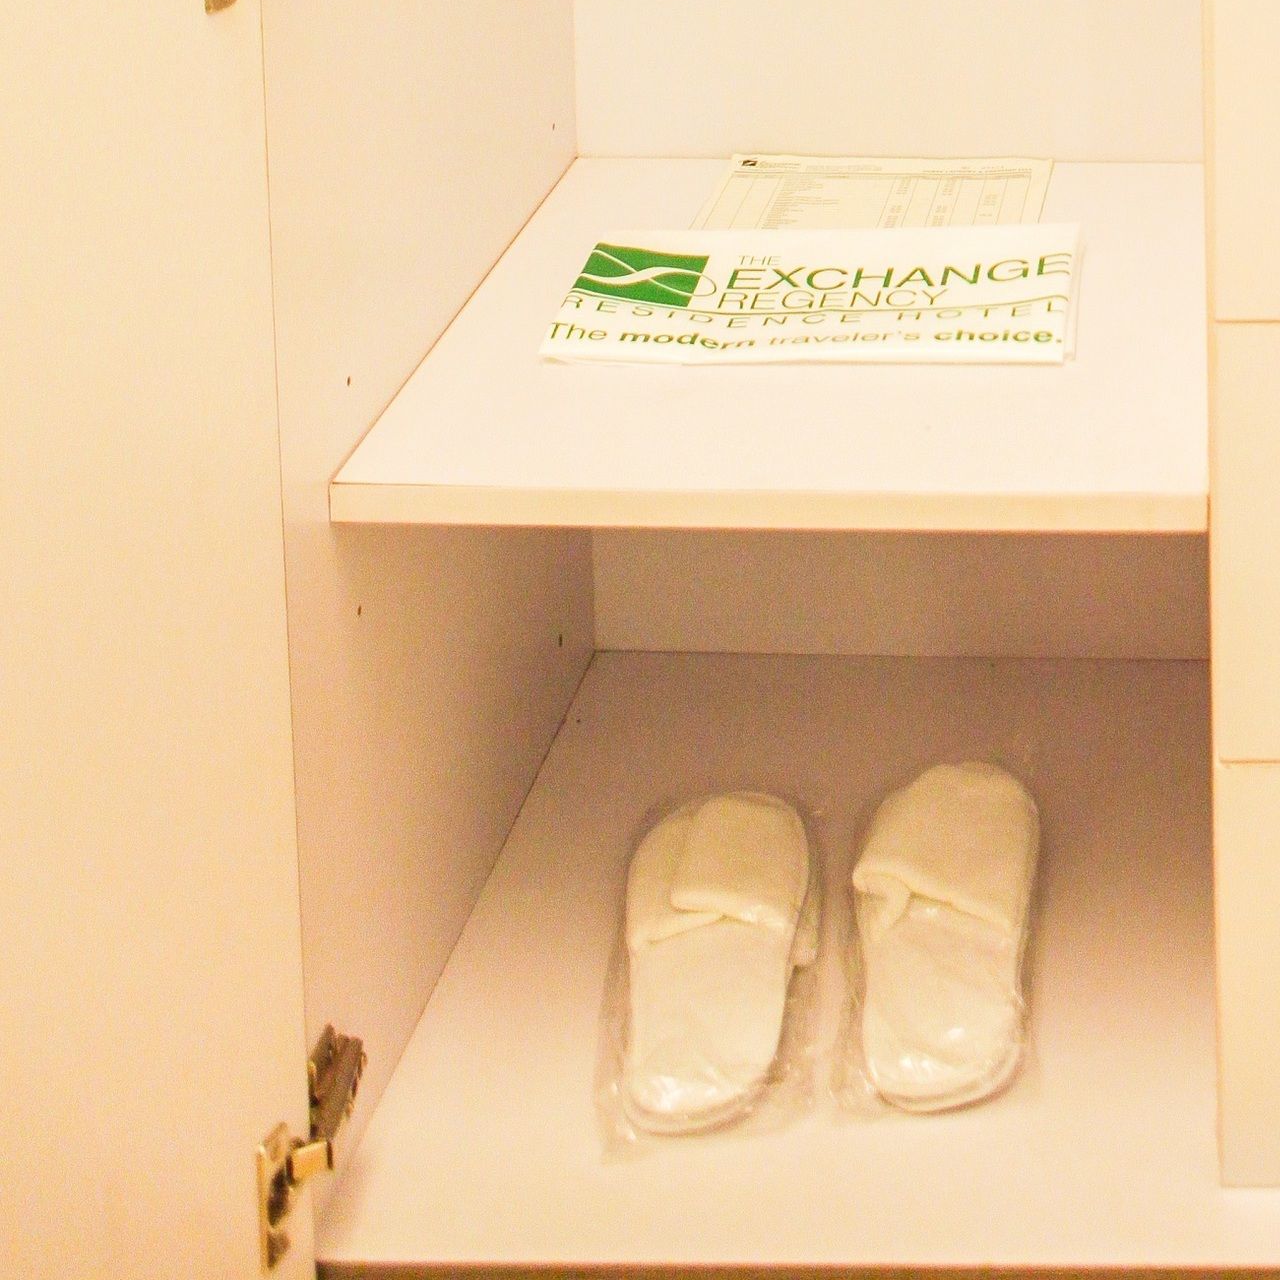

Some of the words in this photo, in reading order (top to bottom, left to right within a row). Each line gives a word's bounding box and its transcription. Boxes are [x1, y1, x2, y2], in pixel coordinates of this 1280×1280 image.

[726, 252, 1072, 290] EXCHANGE
[738, 255, 782, 267] THE
[561, 295, 863, 328] RESIDENCE
[897, 301, 1066, 321] HOTEL
[717, 288, 948, 310] REGENCY
[550, 322, 607, 341] The
[619, 332, 755, 350] modern
[768, 330, 921, 346] traveler's
[933, 329, 1062, 343] choice.
